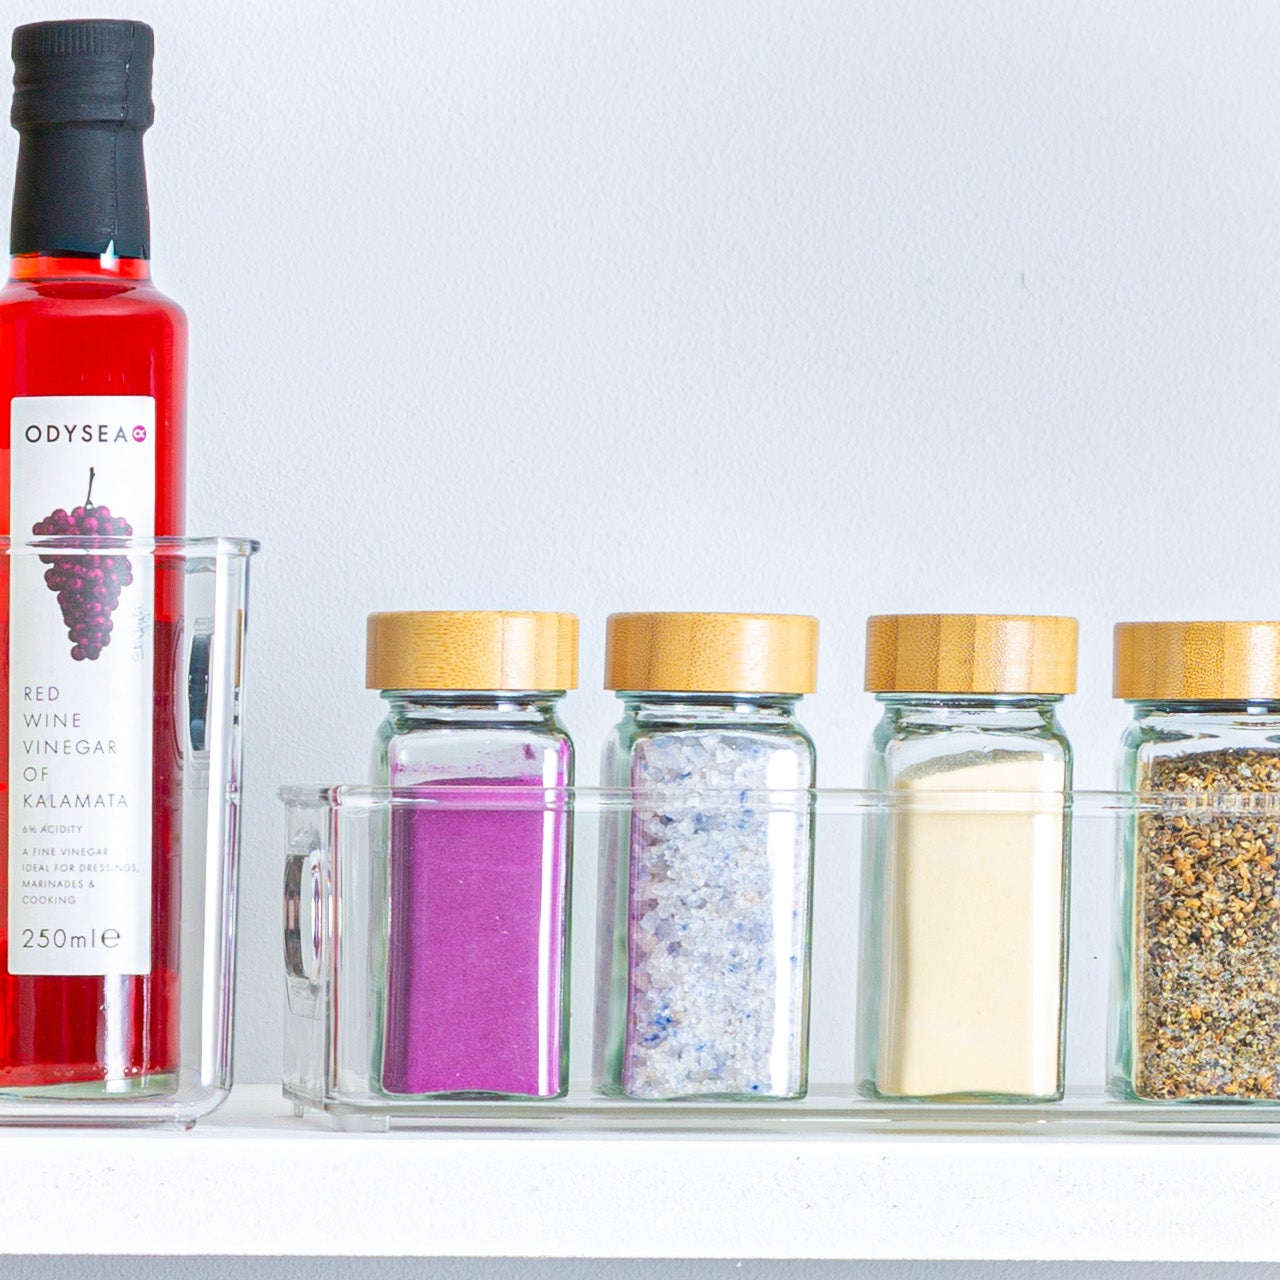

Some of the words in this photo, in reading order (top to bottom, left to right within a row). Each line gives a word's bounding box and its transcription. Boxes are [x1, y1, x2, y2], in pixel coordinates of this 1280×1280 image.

[24, 686, 59, 701] RED
[24, 713, 81, 728] WINE
[23, 740, 117, 755] VINEGAR
[24, 767, 49, 782] OF
[23, 794, 128, 809] KALAMATA
[23, 825, 37, 834] 6%
[41, 825, 83, 834] ACIDITY
[23, 896, 76, 904] COOKING
[22, 929, 97, 949] 250ml
